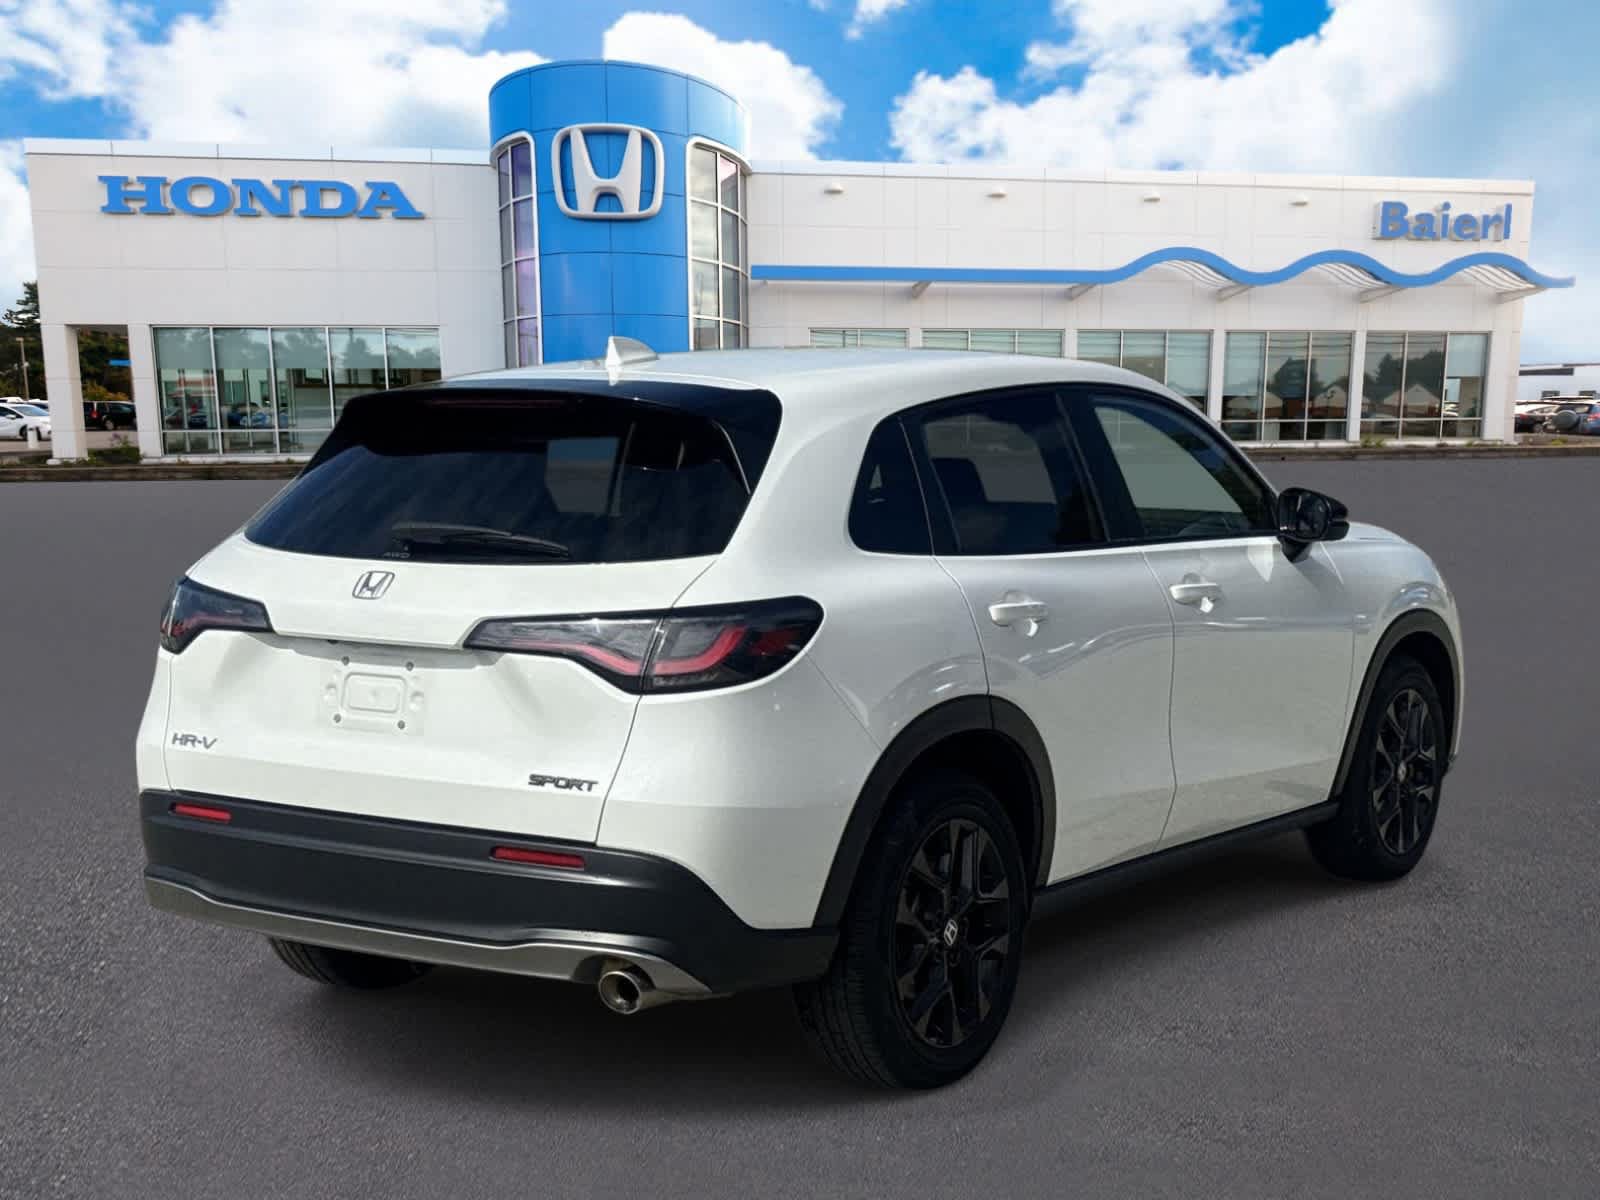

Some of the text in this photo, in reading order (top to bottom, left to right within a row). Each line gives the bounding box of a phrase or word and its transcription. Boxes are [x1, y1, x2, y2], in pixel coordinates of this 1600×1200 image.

[98, 175, 425, 219] HONDA
[1380, 200, 1513, 240] Baierl
[171, 732, 218, 750] HR-V
[528, 773, 599, 792] SPORT
